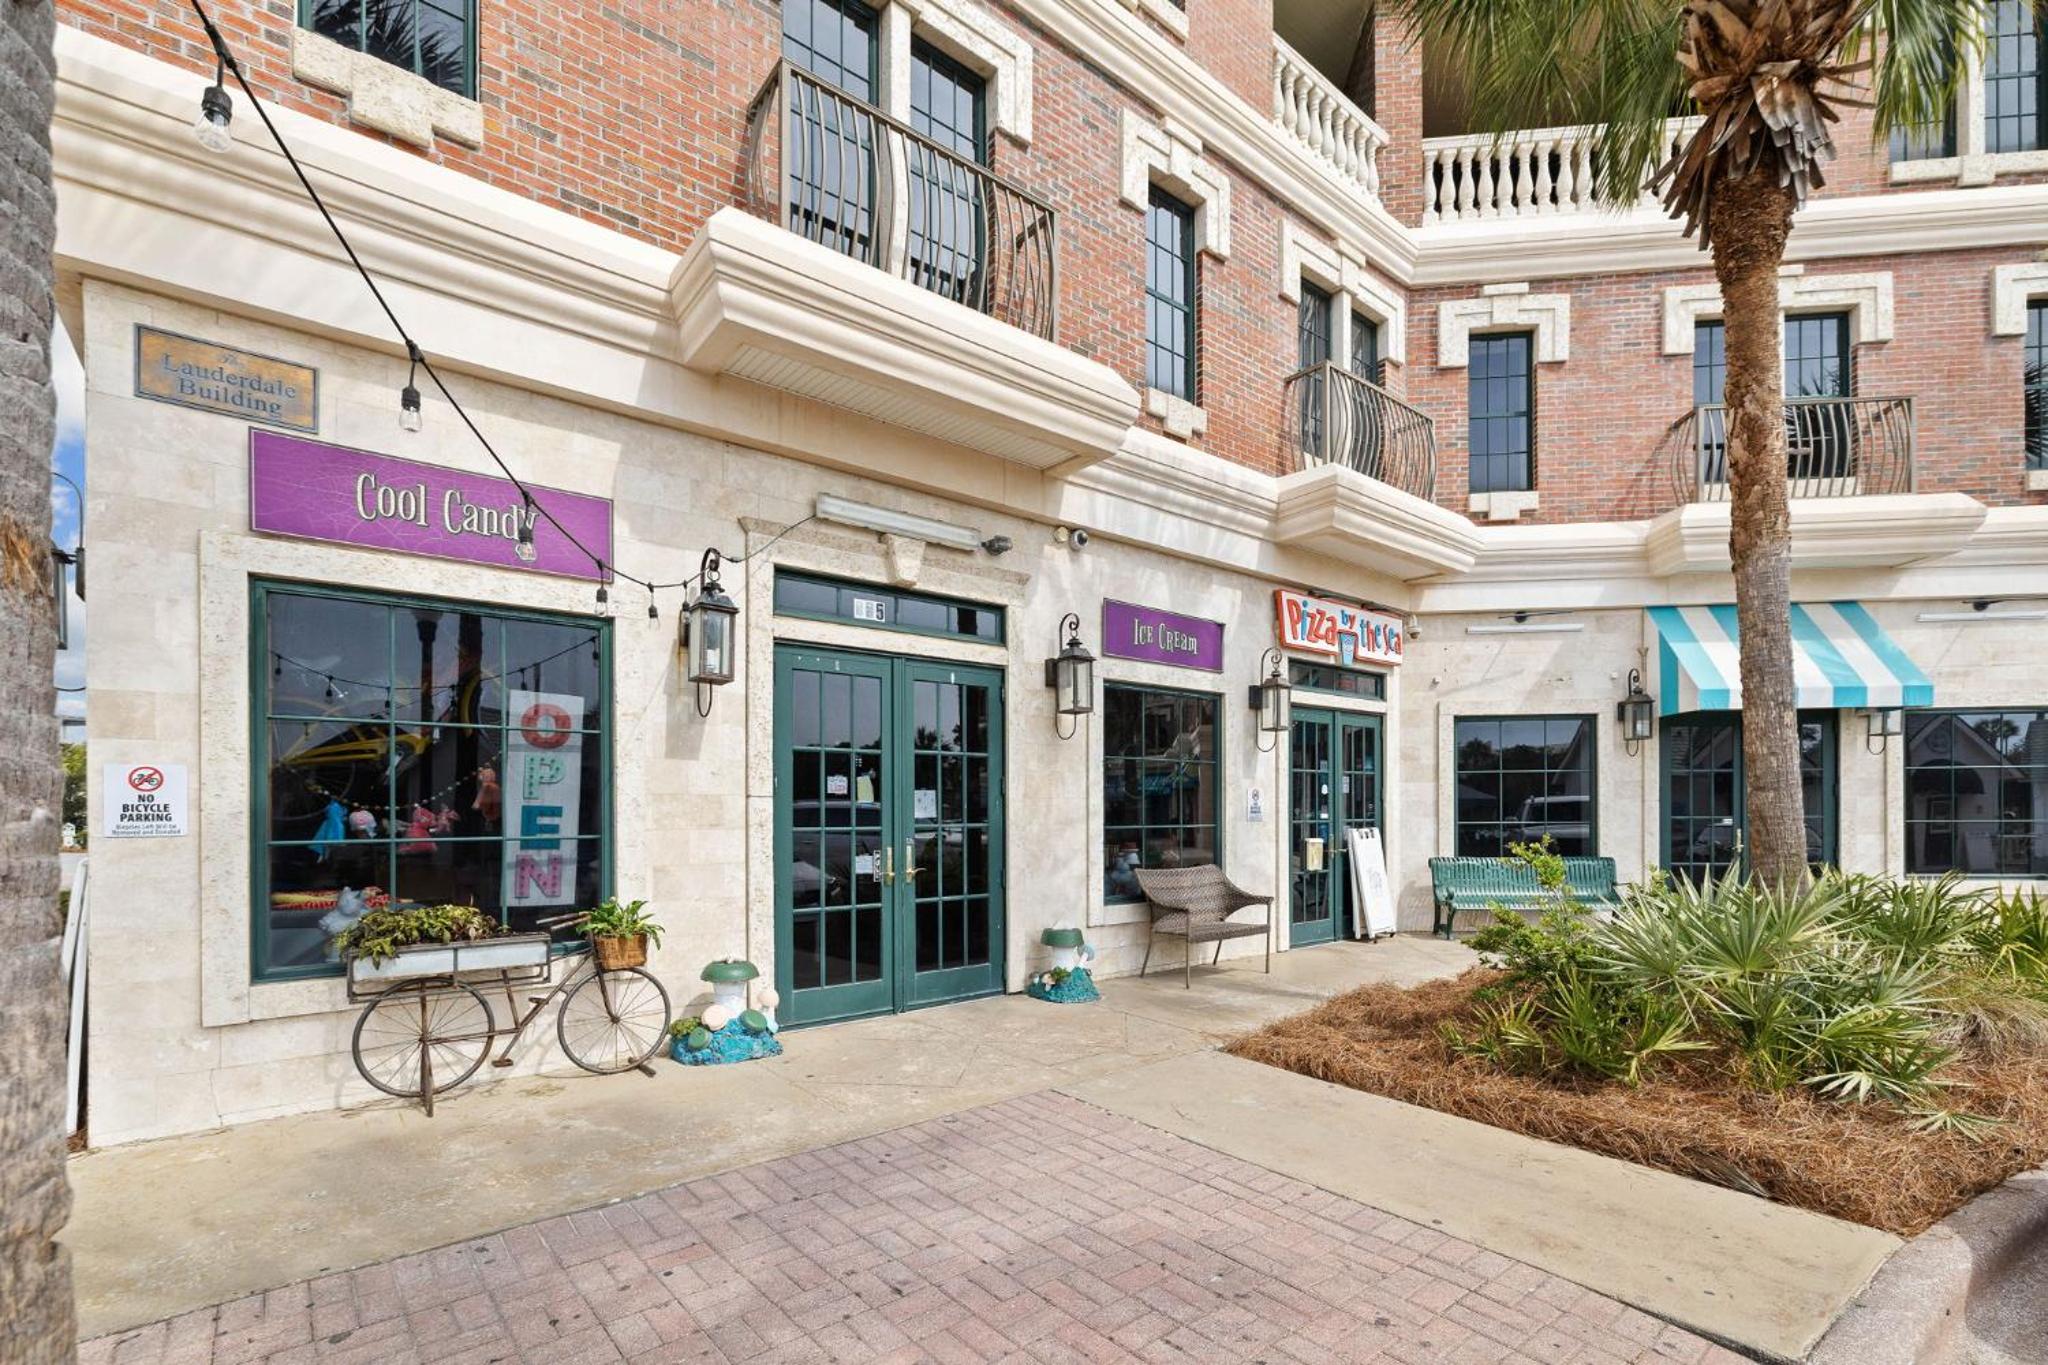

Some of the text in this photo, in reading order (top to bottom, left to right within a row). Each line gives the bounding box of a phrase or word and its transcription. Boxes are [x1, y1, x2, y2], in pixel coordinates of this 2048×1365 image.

[162, 352, 296, 398] Lauderdale
[179, 377, 282, 418] Building
[356, 472, 540, 549] Cool Candy
[1286, 598, 1337, 646] Pizza
[1341, 609, 1356, 629] by
[1360, 619, 1381, 651] the
[119, 813, 173, 822] PARKING
[122, 803, 169, 813] BICYCLE
[137, 794, 155, 803] NO
[514, 703, 572, 899] OPEN
